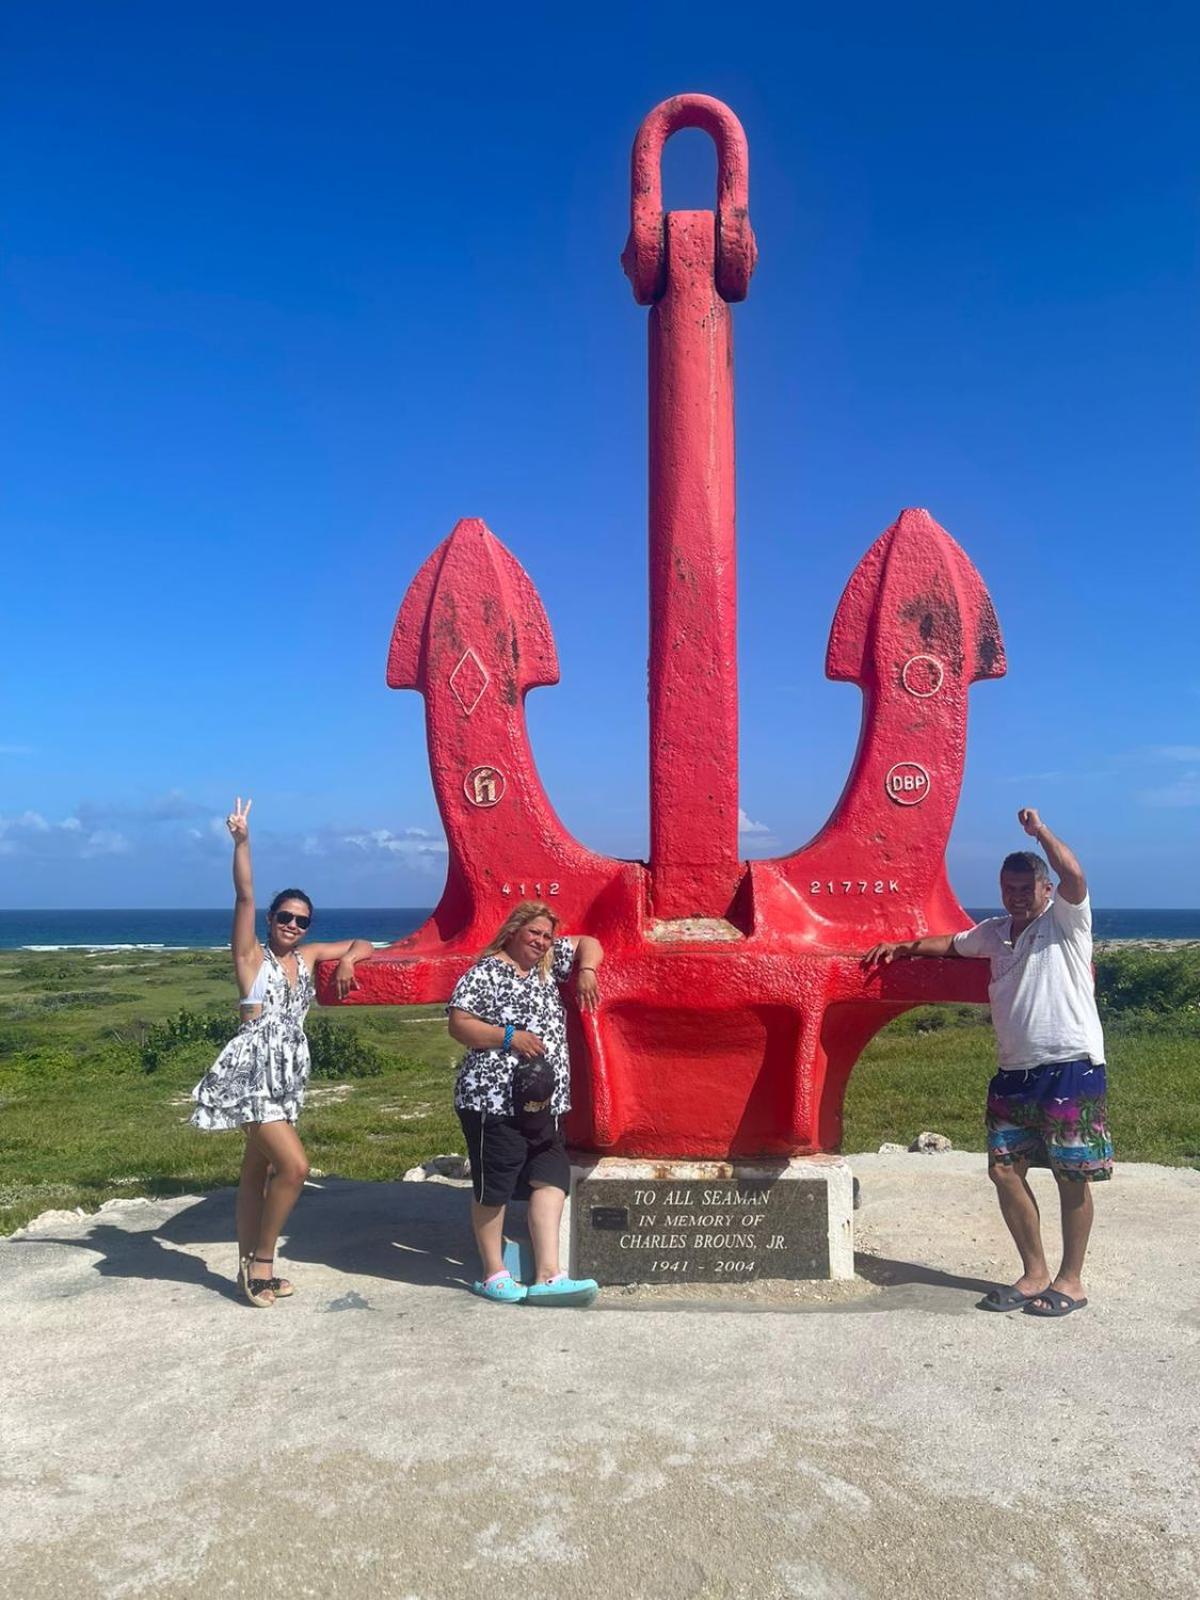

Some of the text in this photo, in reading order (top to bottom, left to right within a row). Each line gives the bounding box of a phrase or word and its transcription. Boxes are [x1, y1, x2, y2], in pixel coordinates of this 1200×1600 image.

[893, 776, 925, 791] DBP
[501, 882, 560, 895] 4112
[810, 880, 899, 894] 21772K
[634, 1190, 771, 1206] TO ALL SEAMAN
[639, 1215, 656, 1227] IN
[664, 1215, 735, 1227] MEMORY
[741, 1215, 766, 1227] OF
[620, 1234, 687, 1249] CHARLES
[766, 1235, 788, 1249] JR.
[650, 1261, 688, 1272] 1941
[714, 1260, 756, 1272] 2004
